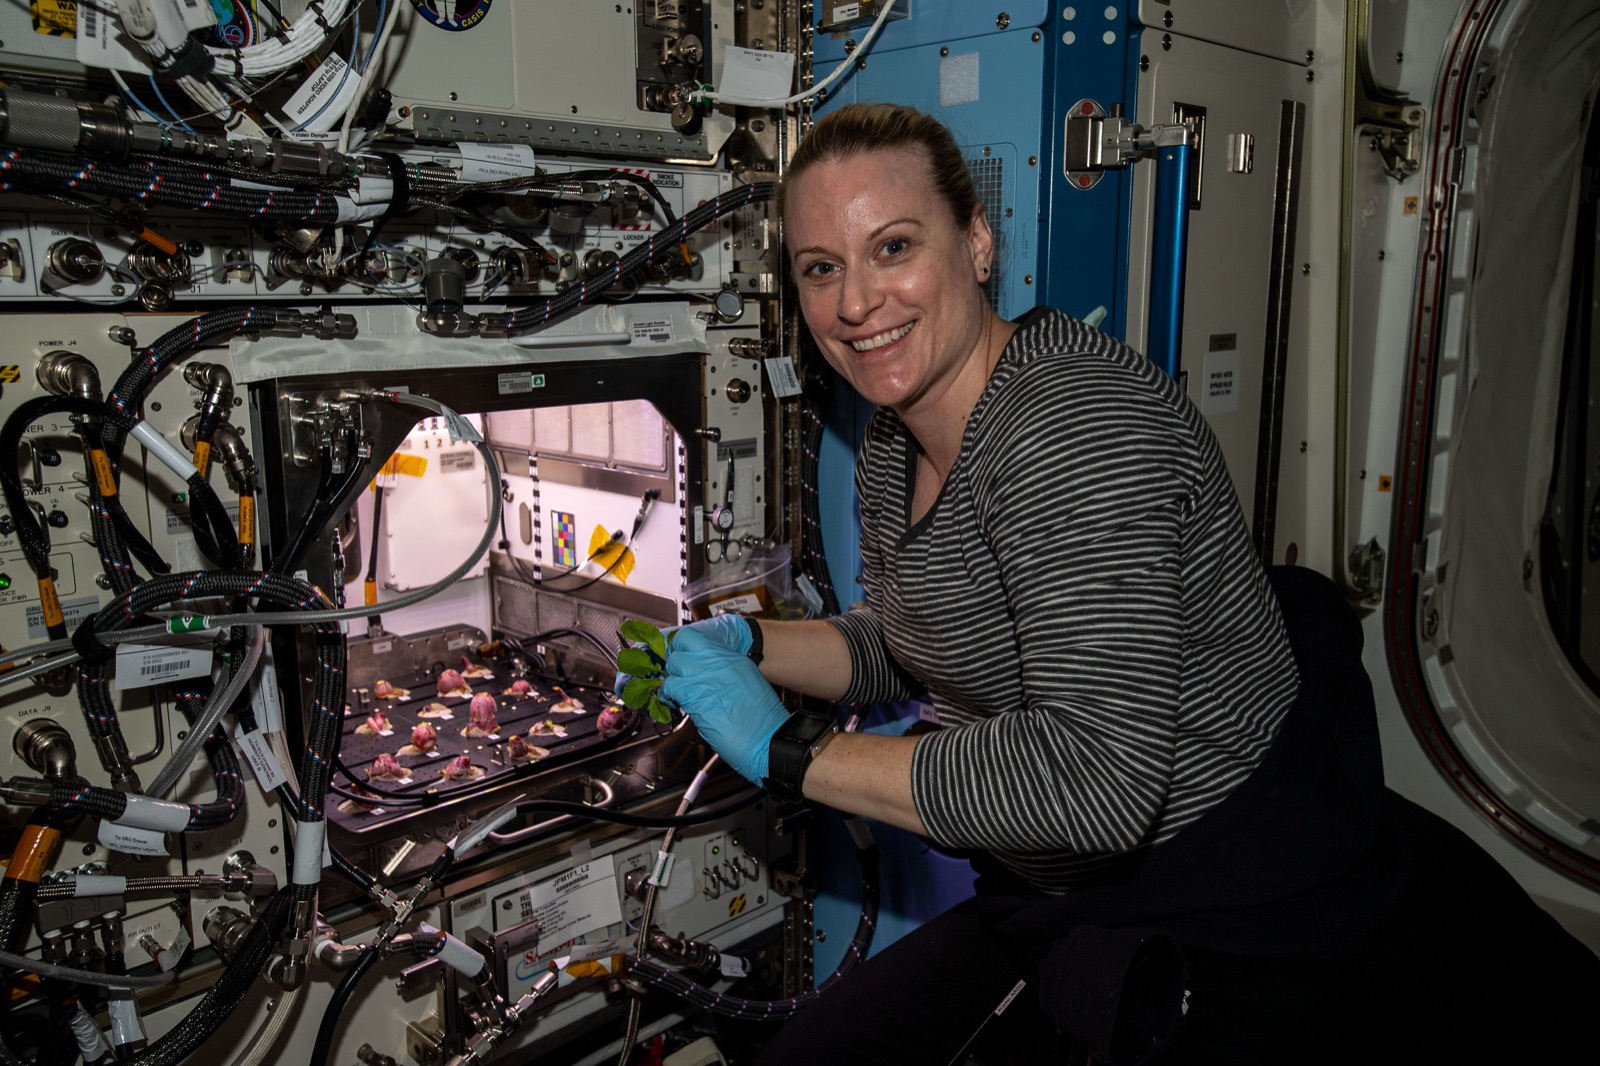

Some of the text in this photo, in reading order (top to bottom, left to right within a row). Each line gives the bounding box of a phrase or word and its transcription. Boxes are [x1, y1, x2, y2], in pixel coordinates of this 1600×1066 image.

[461, 8, 484, 28] CASIS
[310, 74, 326, 92] LAPTOP
[316, 81, 329, 95] VIDEO
[296, 94, 317, 115] ADAPTER
[190, 284, 202, 294] J1
[424, 440, 429, 449] 1
[437, 439, 442, 447] 2
[23, 487, 51, 496] OWER
[715, 600, 735, 610] Waste
[18, 708, 38, 717] DATA
[248, 738, 273, 785] HUMIDITY CONTROL
[552, 864, 590, 887] JPM1F1_L2
[138, 923, 161, 934] OUTLET
